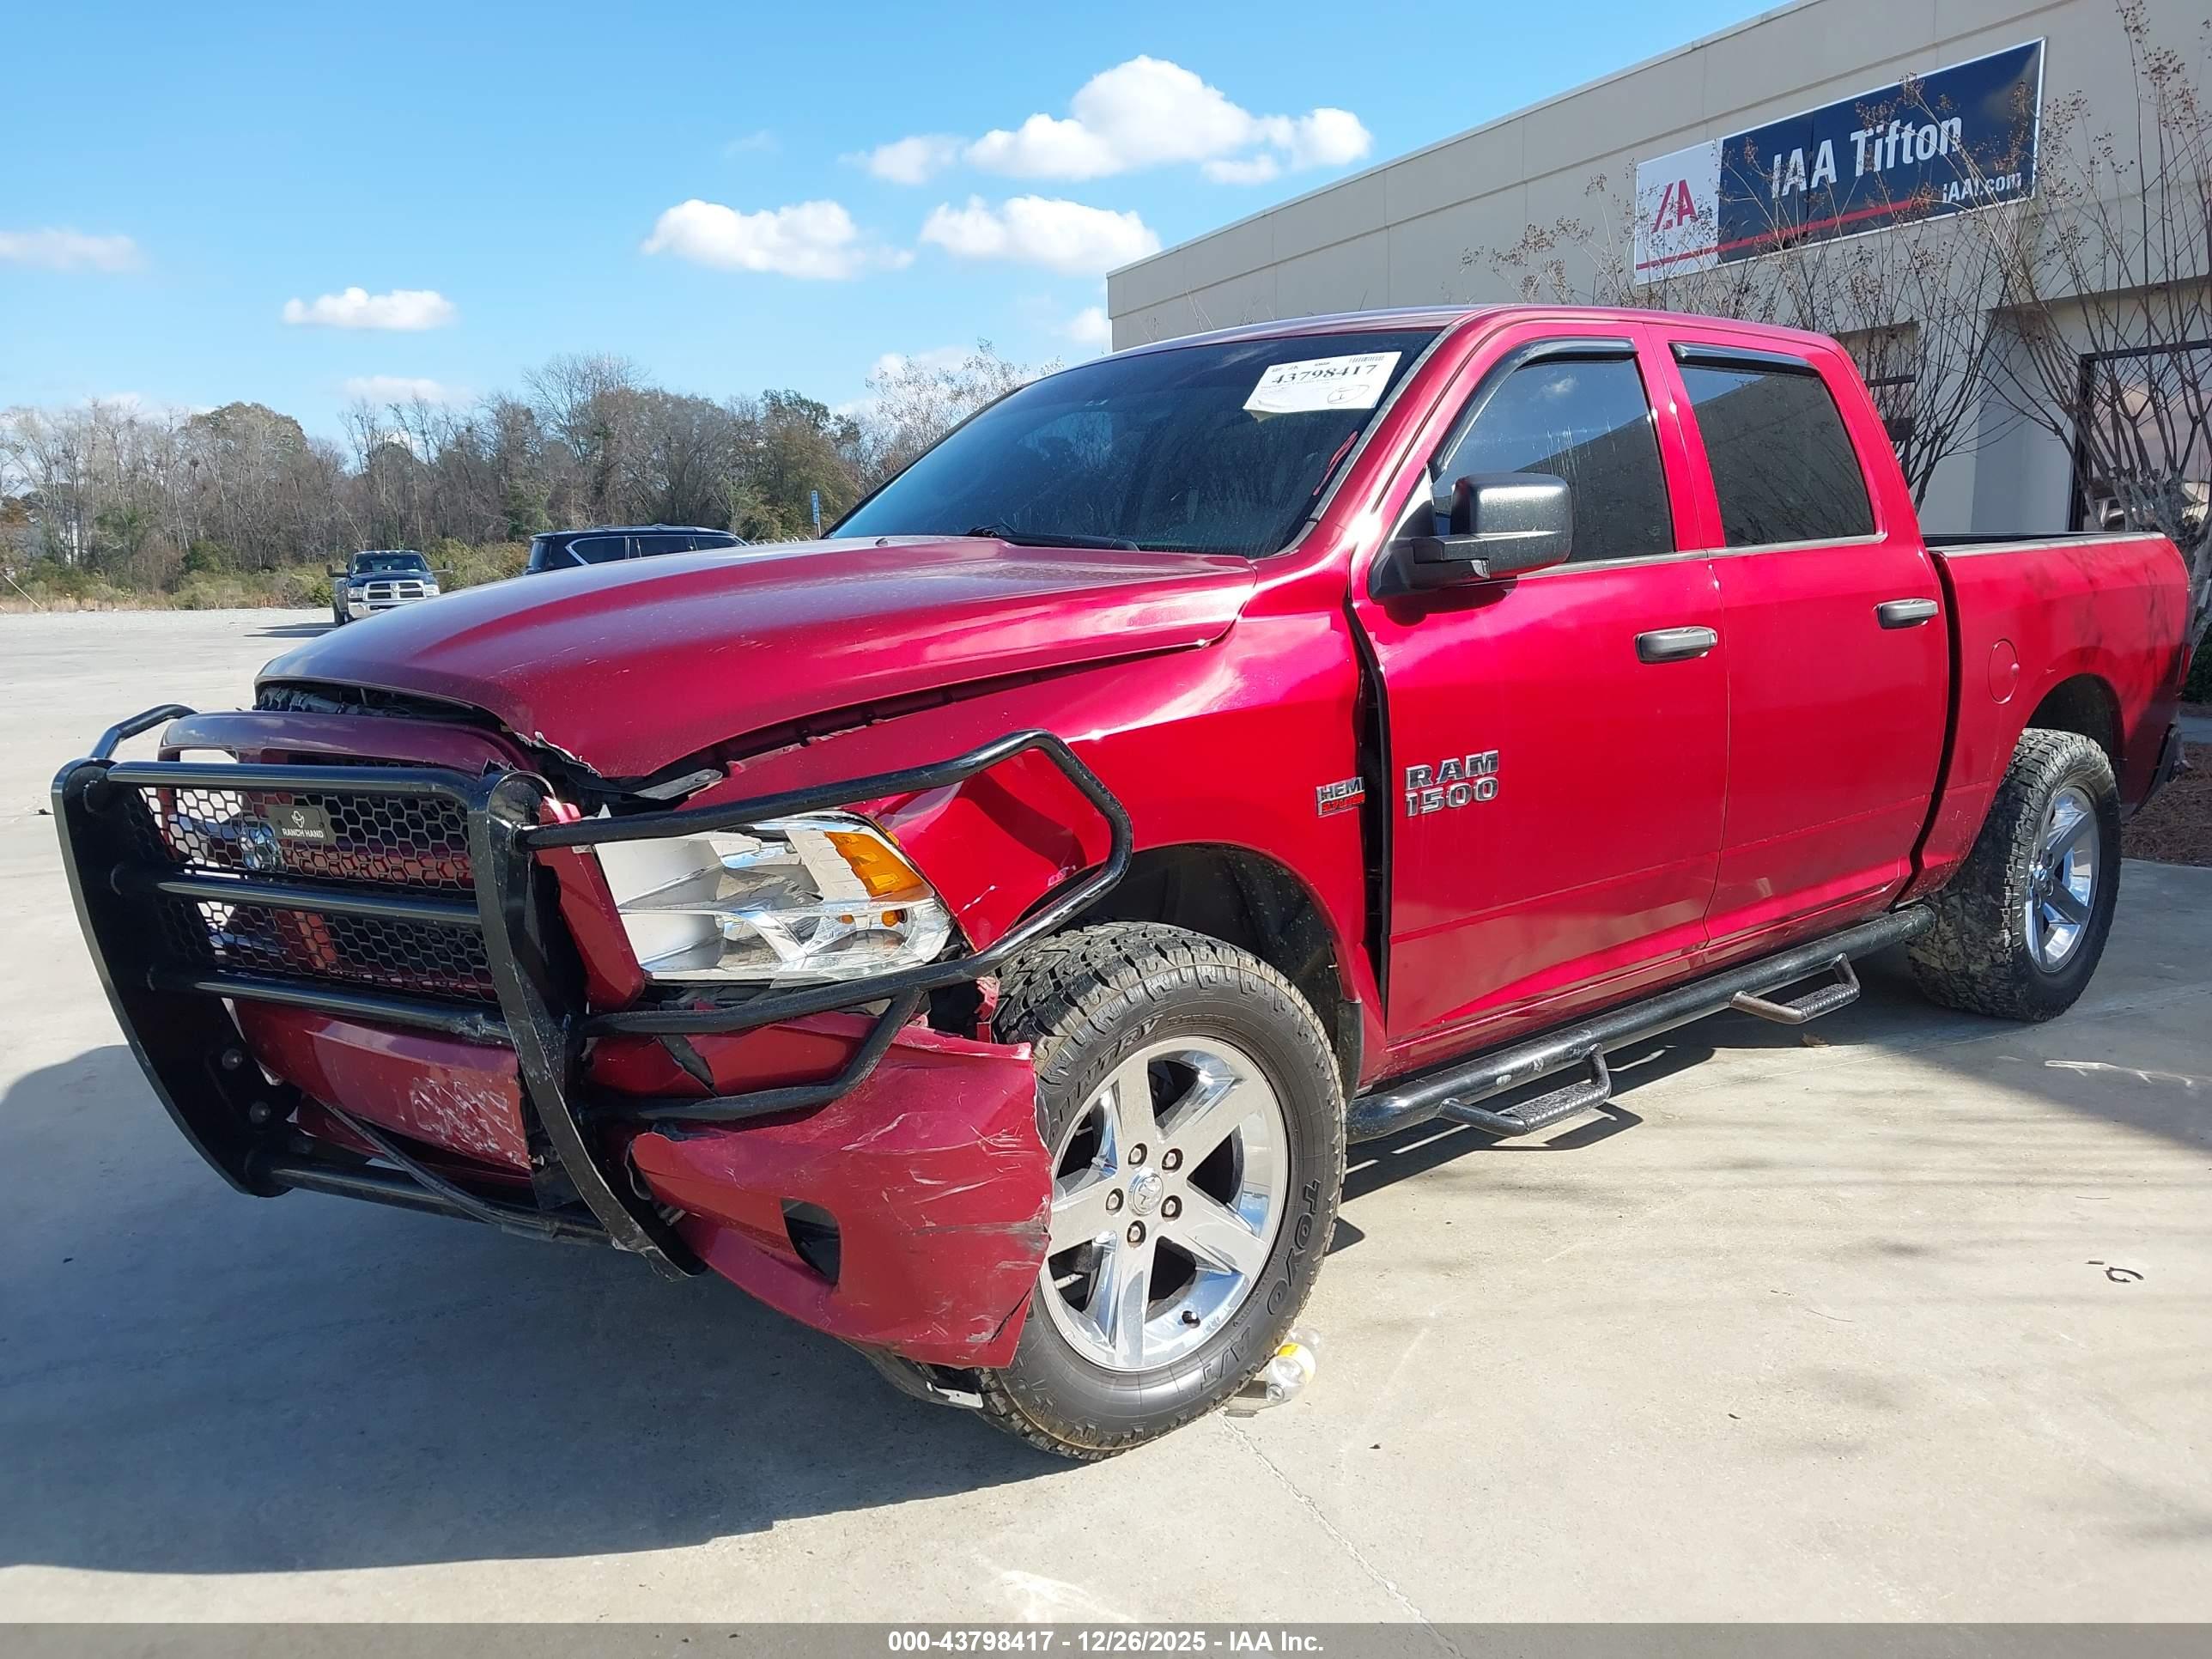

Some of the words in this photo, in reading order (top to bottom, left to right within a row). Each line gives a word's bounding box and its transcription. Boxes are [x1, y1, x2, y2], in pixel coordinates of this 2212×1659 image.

[1772, 138, 1838, 199] IAA
[1850, 117, 1964, 179] Tifton
[1272, 364, 1377, 384] 43798417
[1404, 750, 1499, 791] RAM
[1405, 776, 1499, 817] 1500
[282, 828, 304, 837] RANCH
[304, 830, 325, 838] HAND
[1048, 1013, 1164, 1142] OUNTRY
[1267, 1178, 1322, 1316] TOYO
